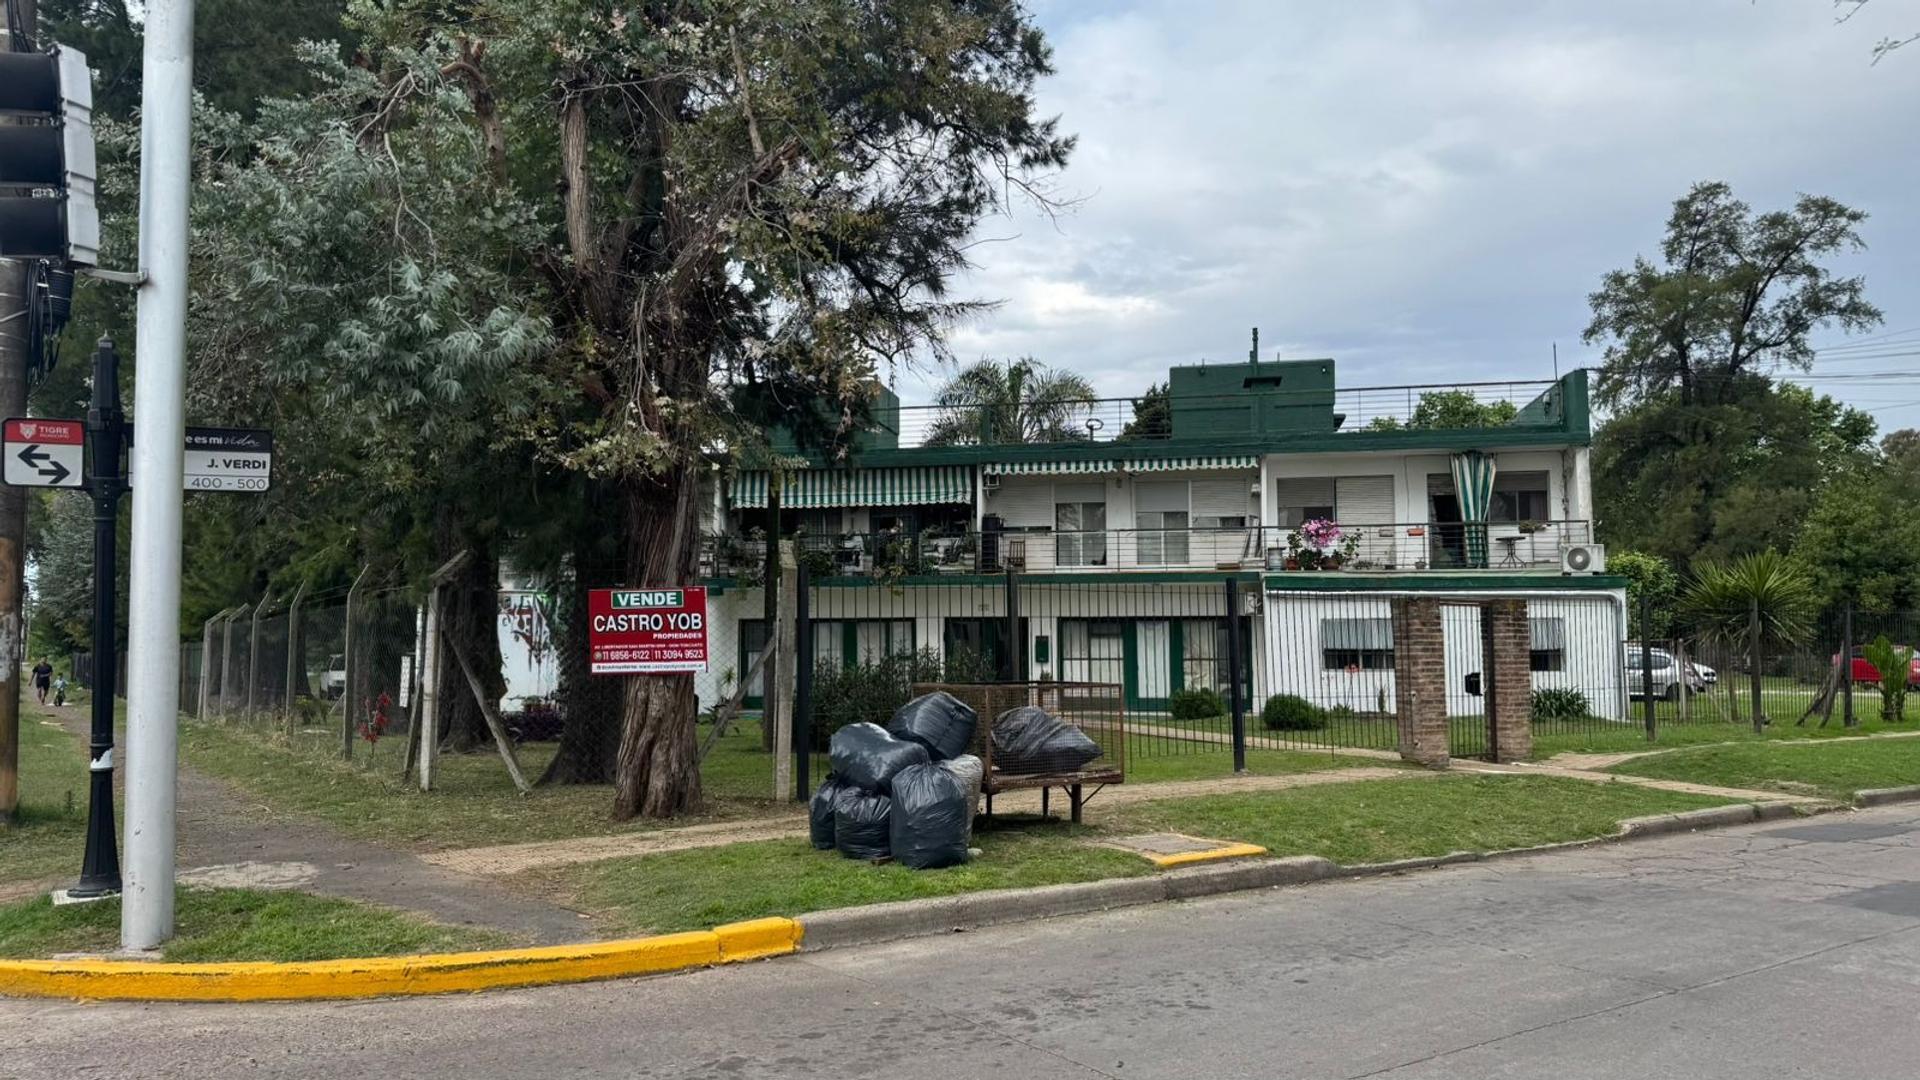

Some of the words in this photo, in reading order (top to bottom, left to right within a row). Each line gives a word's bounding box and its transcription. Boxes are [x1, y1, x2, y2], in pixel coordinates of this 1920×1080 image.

[39, 425, 70, 434] TIGRE
[194, 435, 208, 444] es
[209, 435, 223, 445] mi
[207, 458, 219, 468] J.
[223, 459, 267, 470] VERDI
[192, 477, 222, 489] 400
[238, 478, 266, 490] 500
[617, 592, 677, 606] VENDE
[594, 613, 663, 632] CASTRO
[667, 613, 702, 630] YOB
[653, 632, 702, 640] PROPIEDADES
